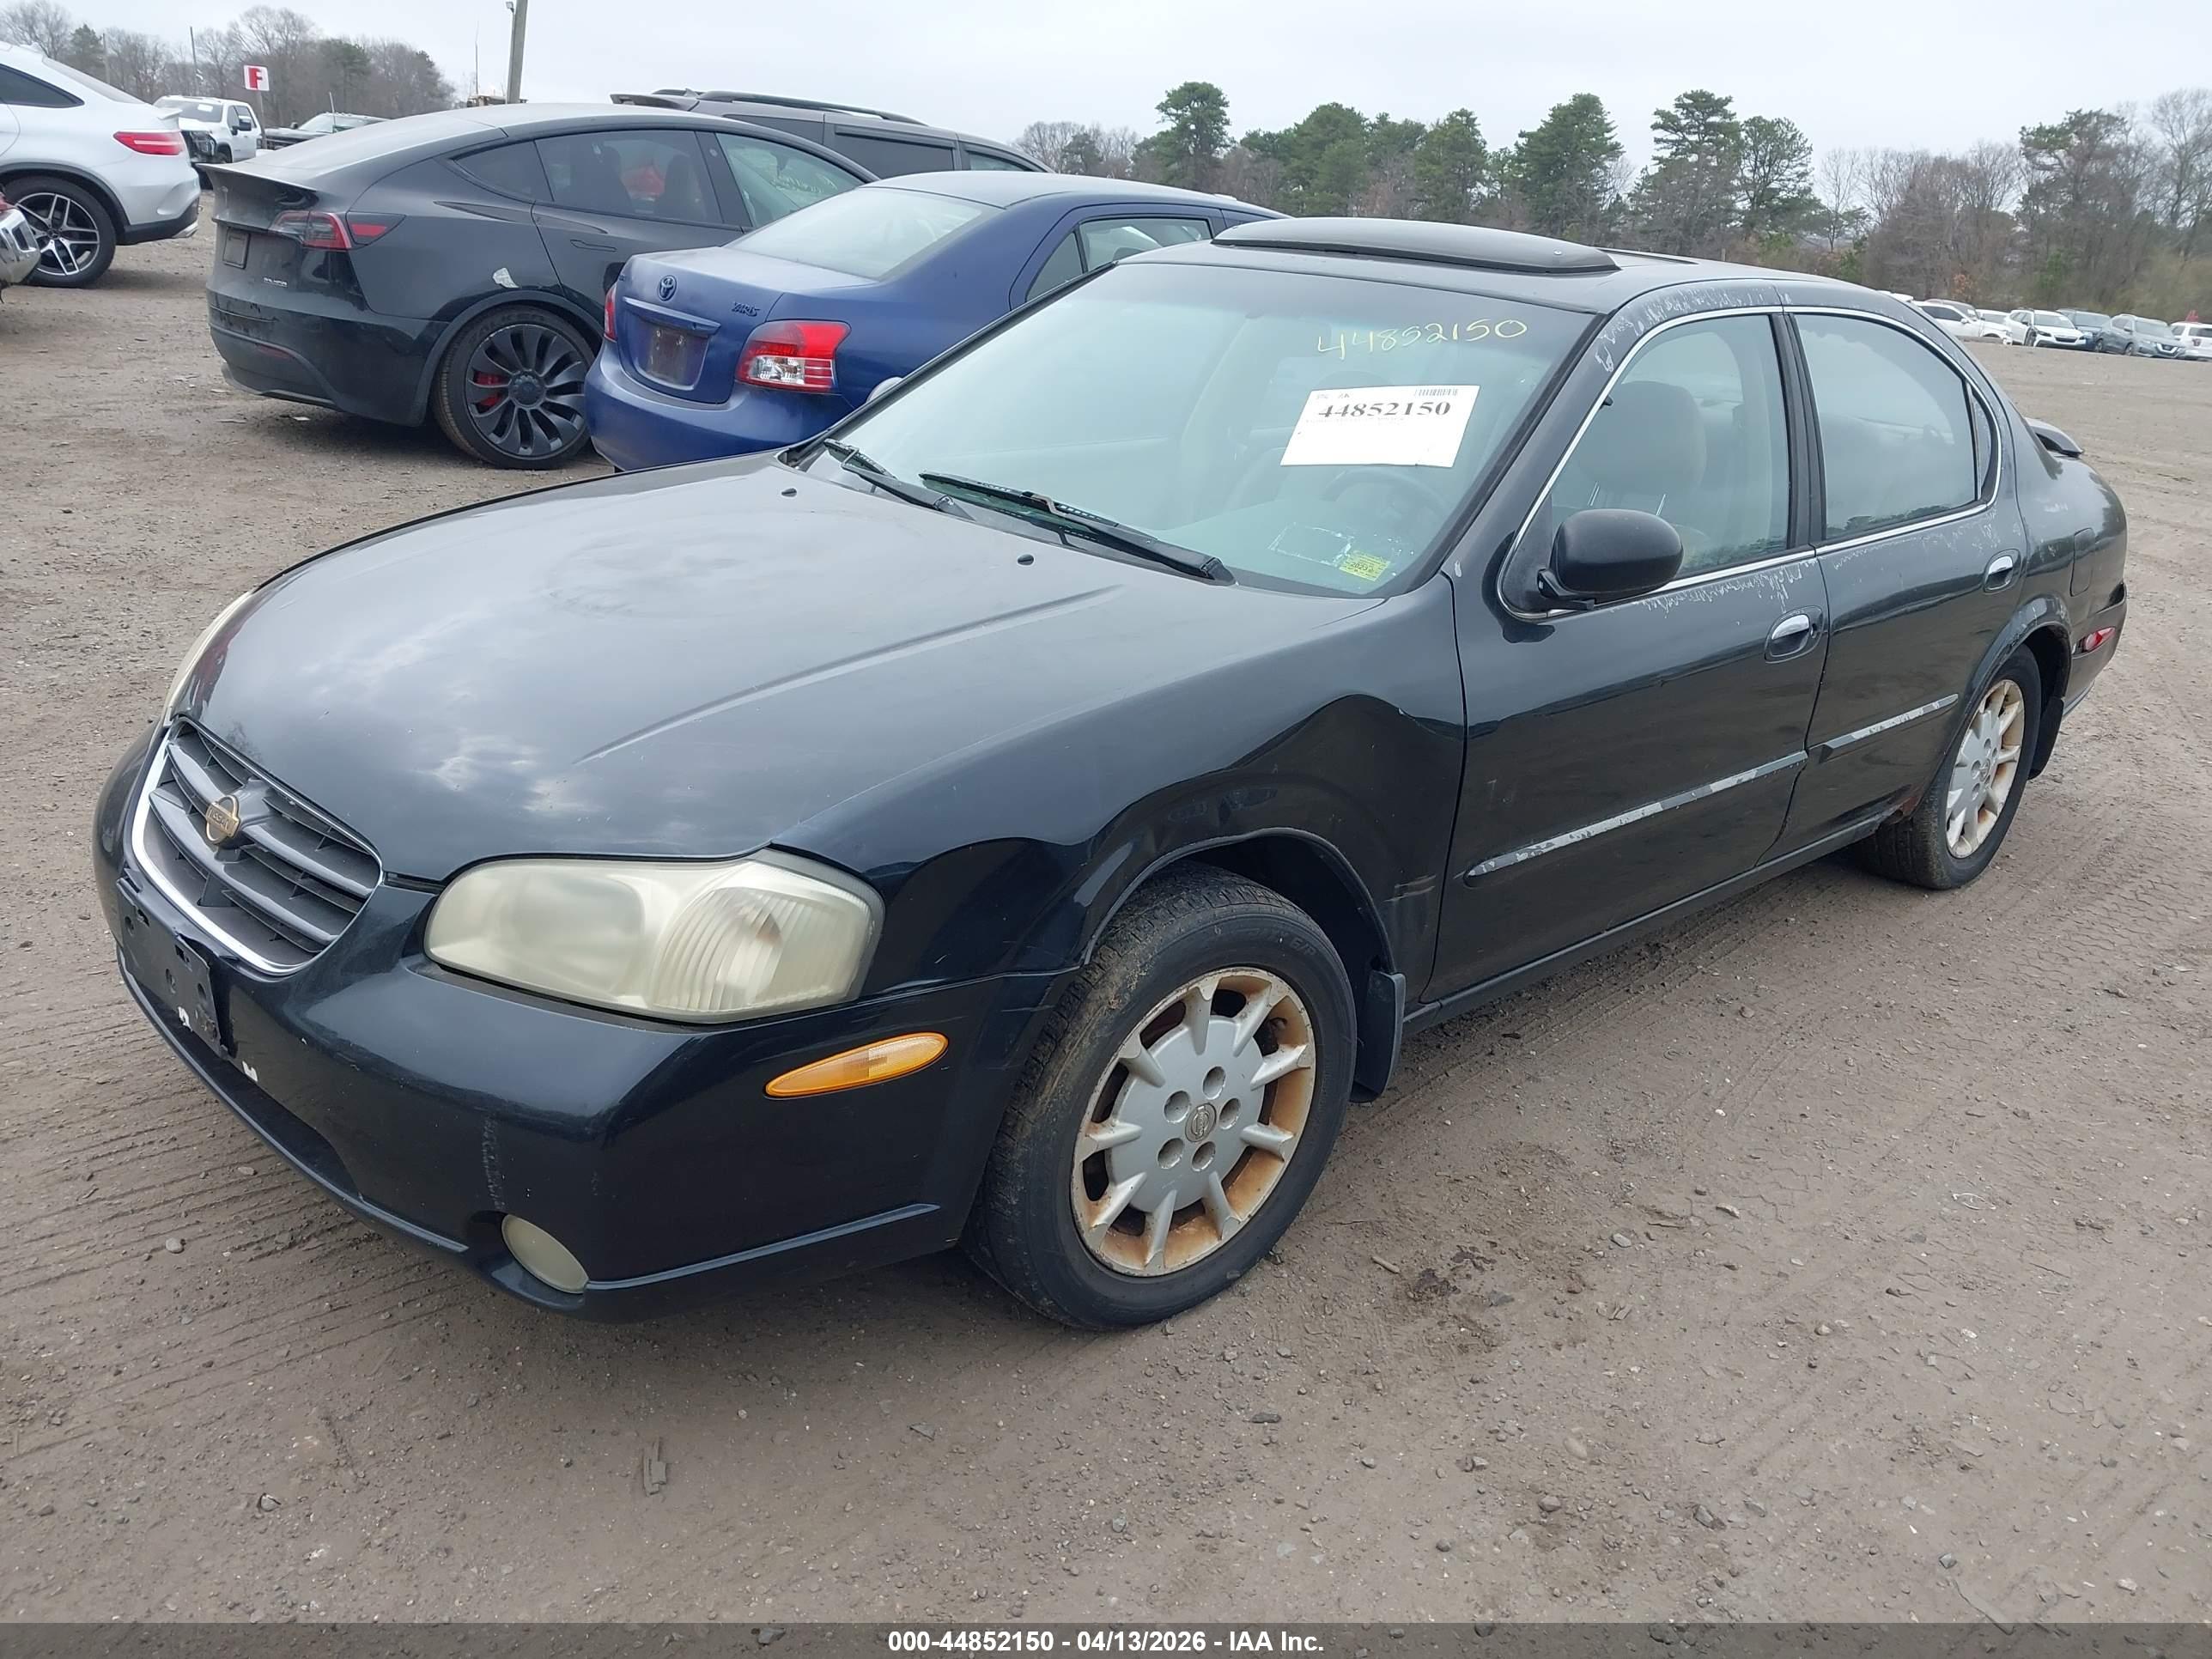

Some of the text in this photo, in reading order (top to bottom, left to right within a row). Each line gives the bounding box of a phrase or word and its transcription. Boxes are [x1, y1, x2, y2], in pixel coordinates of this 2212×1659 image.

[249, 68, 263, 89] F
[1317, 319, 1528, 360] 44852150
[1318, 401, 1451, 417] 44852150
